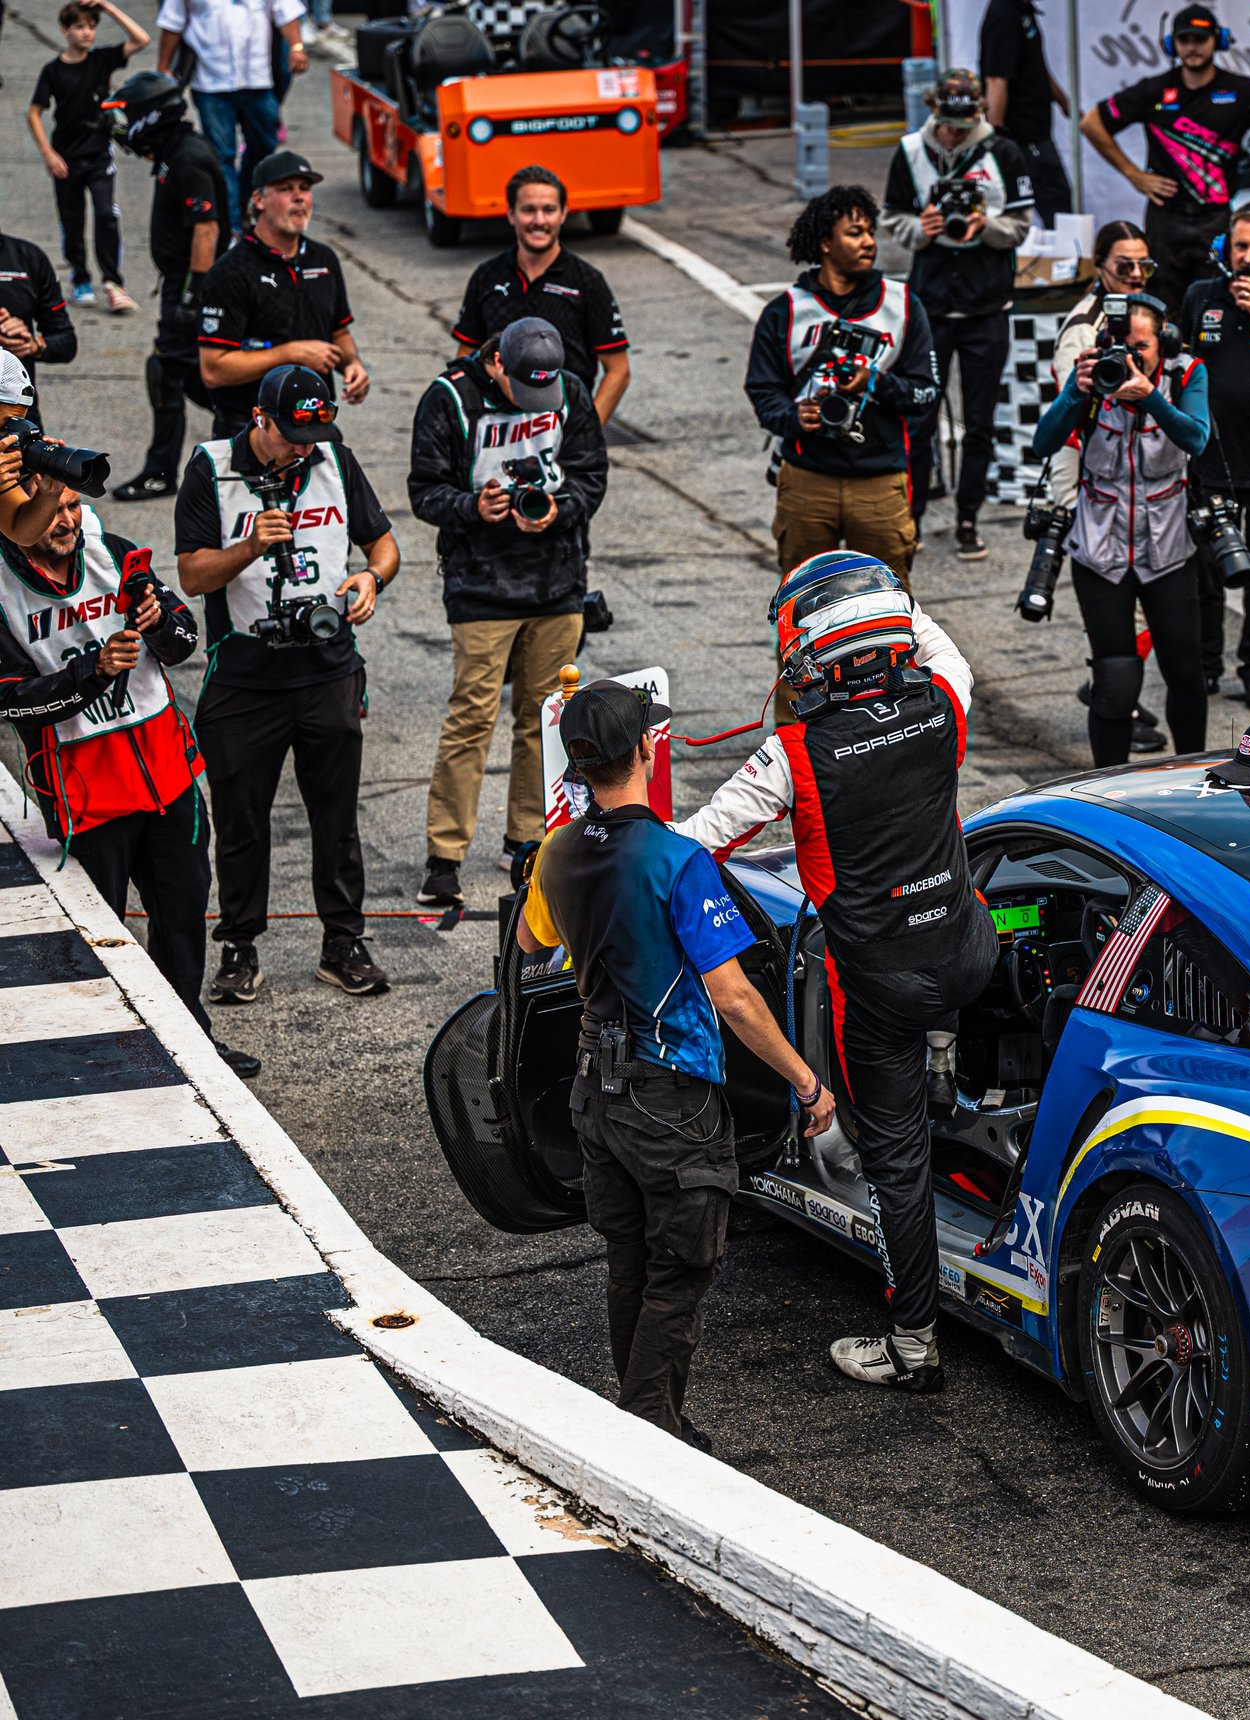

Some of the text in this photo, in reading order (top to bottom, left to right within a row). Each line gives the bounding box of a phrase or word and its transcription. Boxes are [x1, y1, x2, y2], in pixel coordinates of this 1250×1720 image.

[510, 115, 600, 133] BIGFOOT
[289, 505, 346, 532] SA
[863, 672, 884, 683] ULTRA
[834, 713, 946, 760] PORSCHE
[901, 868, 952, 898] RACEBORN
[714, 894, 731, 909] Ape
[907, 906, 947, 925] sparco
[996, 912, 1029, 926] N 0
[749, 1175, 804, 1209] YOKOHAMA
[807, 1199, 846, 1229] sparco
[1099, 1200, 1161, 1244] ADVAN
[855, 1225, 880, 1246] EBO
[980, 1295, 1002, 1313] OLAIRUS
